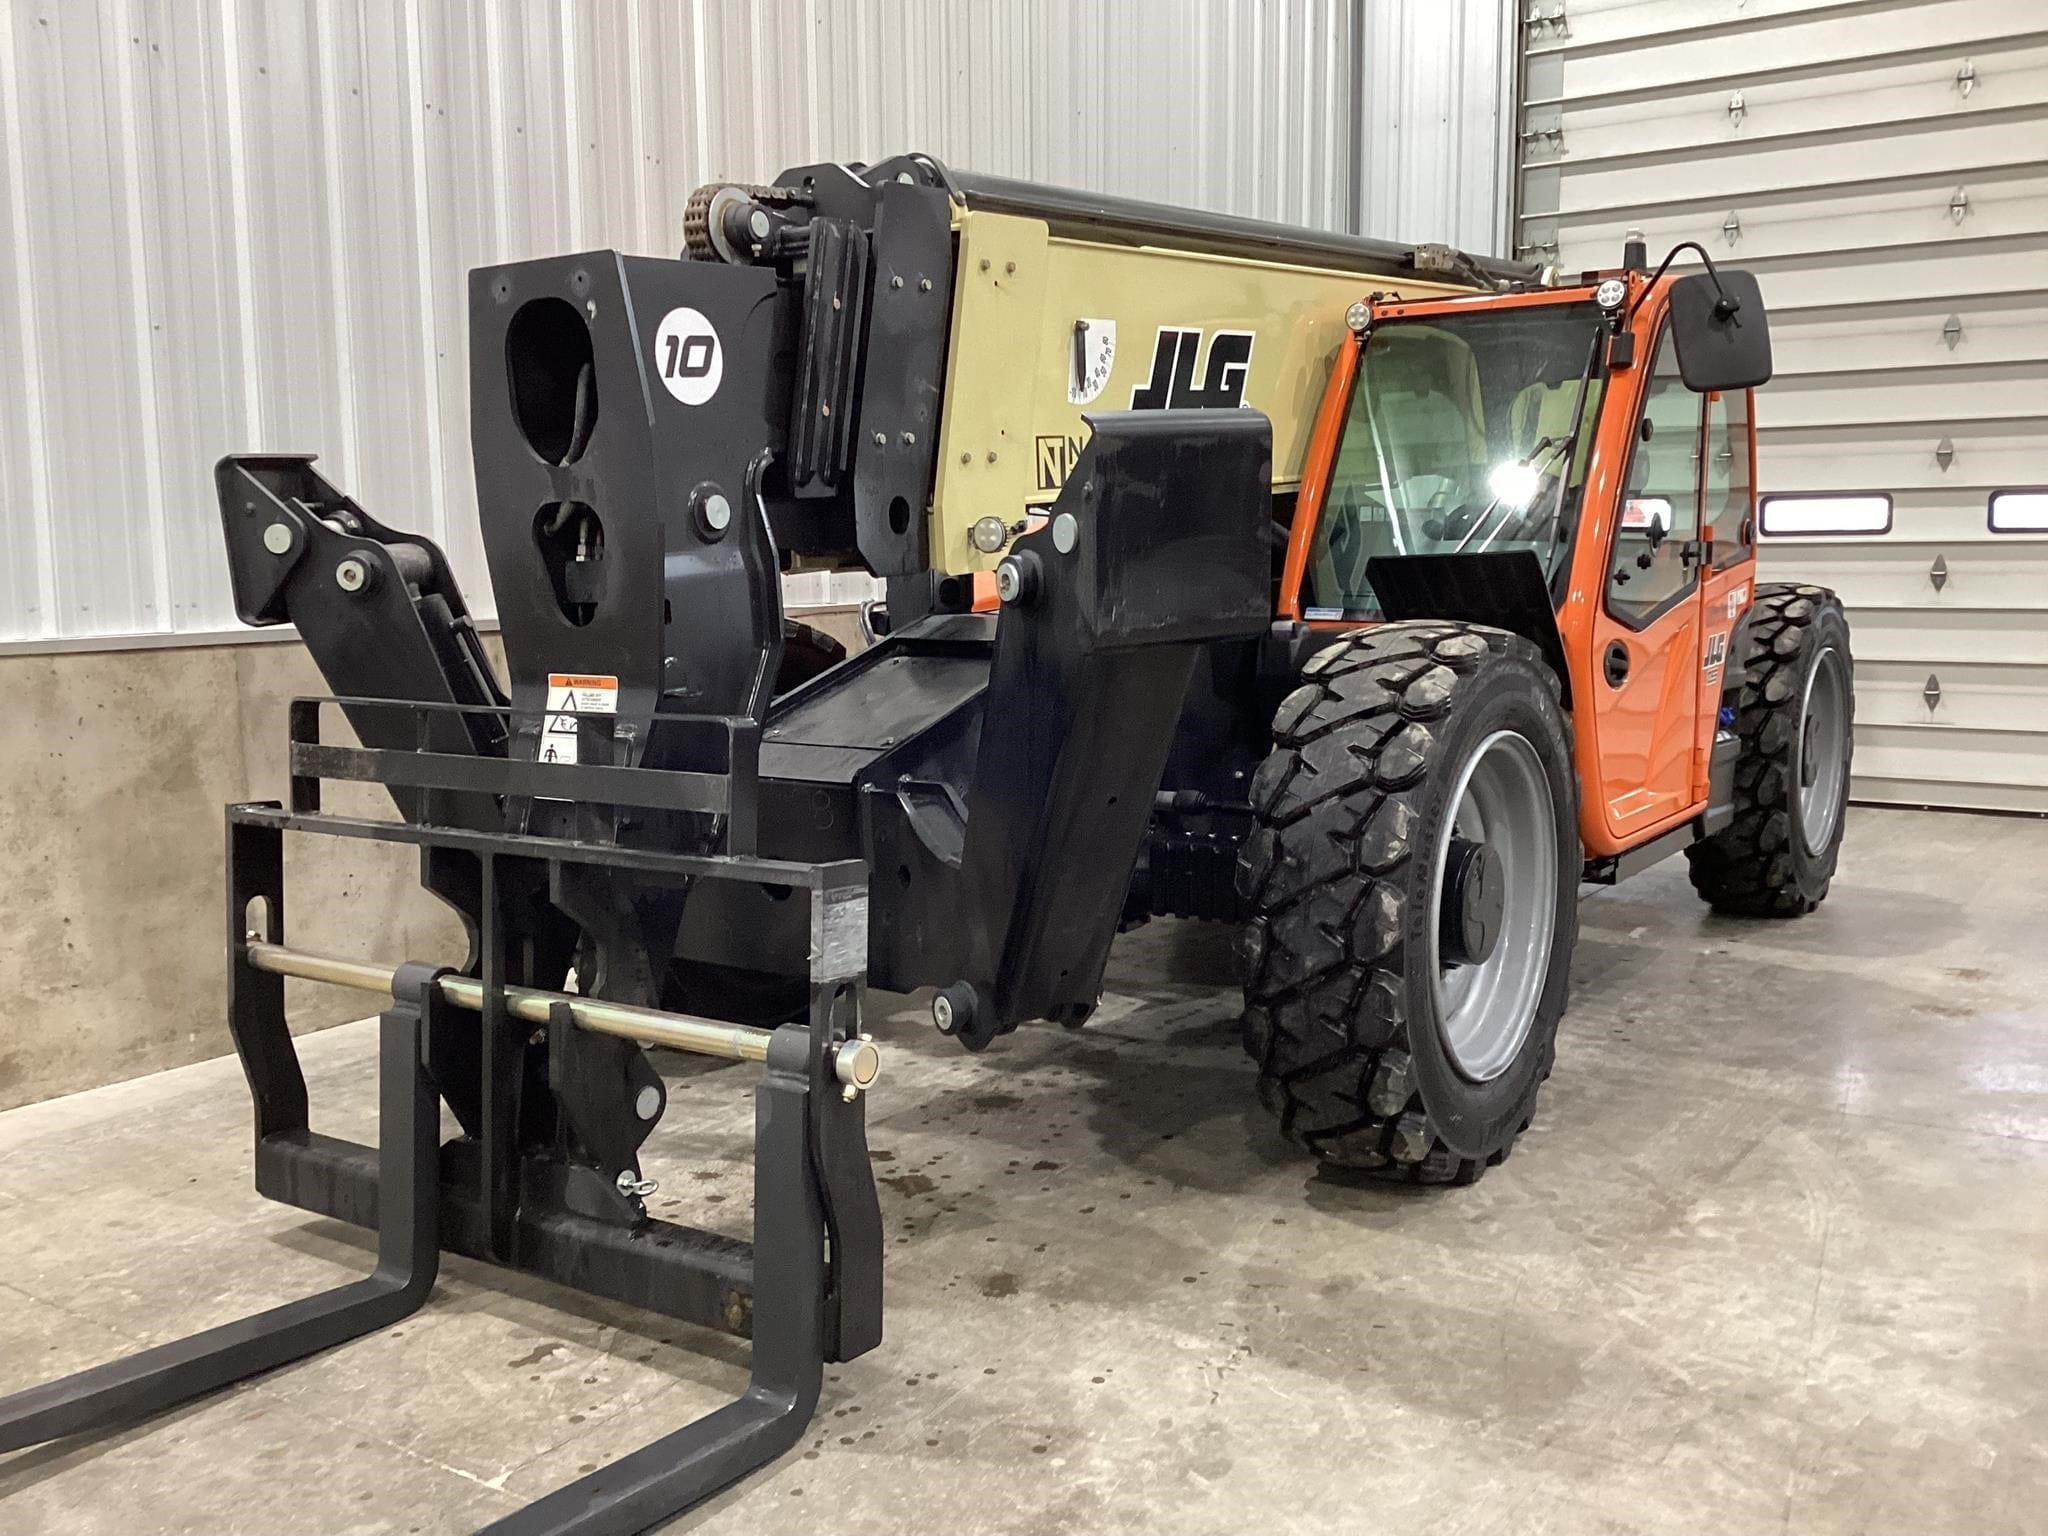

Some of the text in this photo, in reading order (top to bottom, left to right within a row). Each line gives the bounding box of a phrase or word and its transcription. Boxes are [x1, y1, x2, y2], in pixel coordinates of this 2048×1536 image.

[665, 335, 714, 378] 10
[1130, 329, 1253, 409] JLG
[1703, 633, 1726, 668] JLG
[573, 679, 602, 687] WARNING
